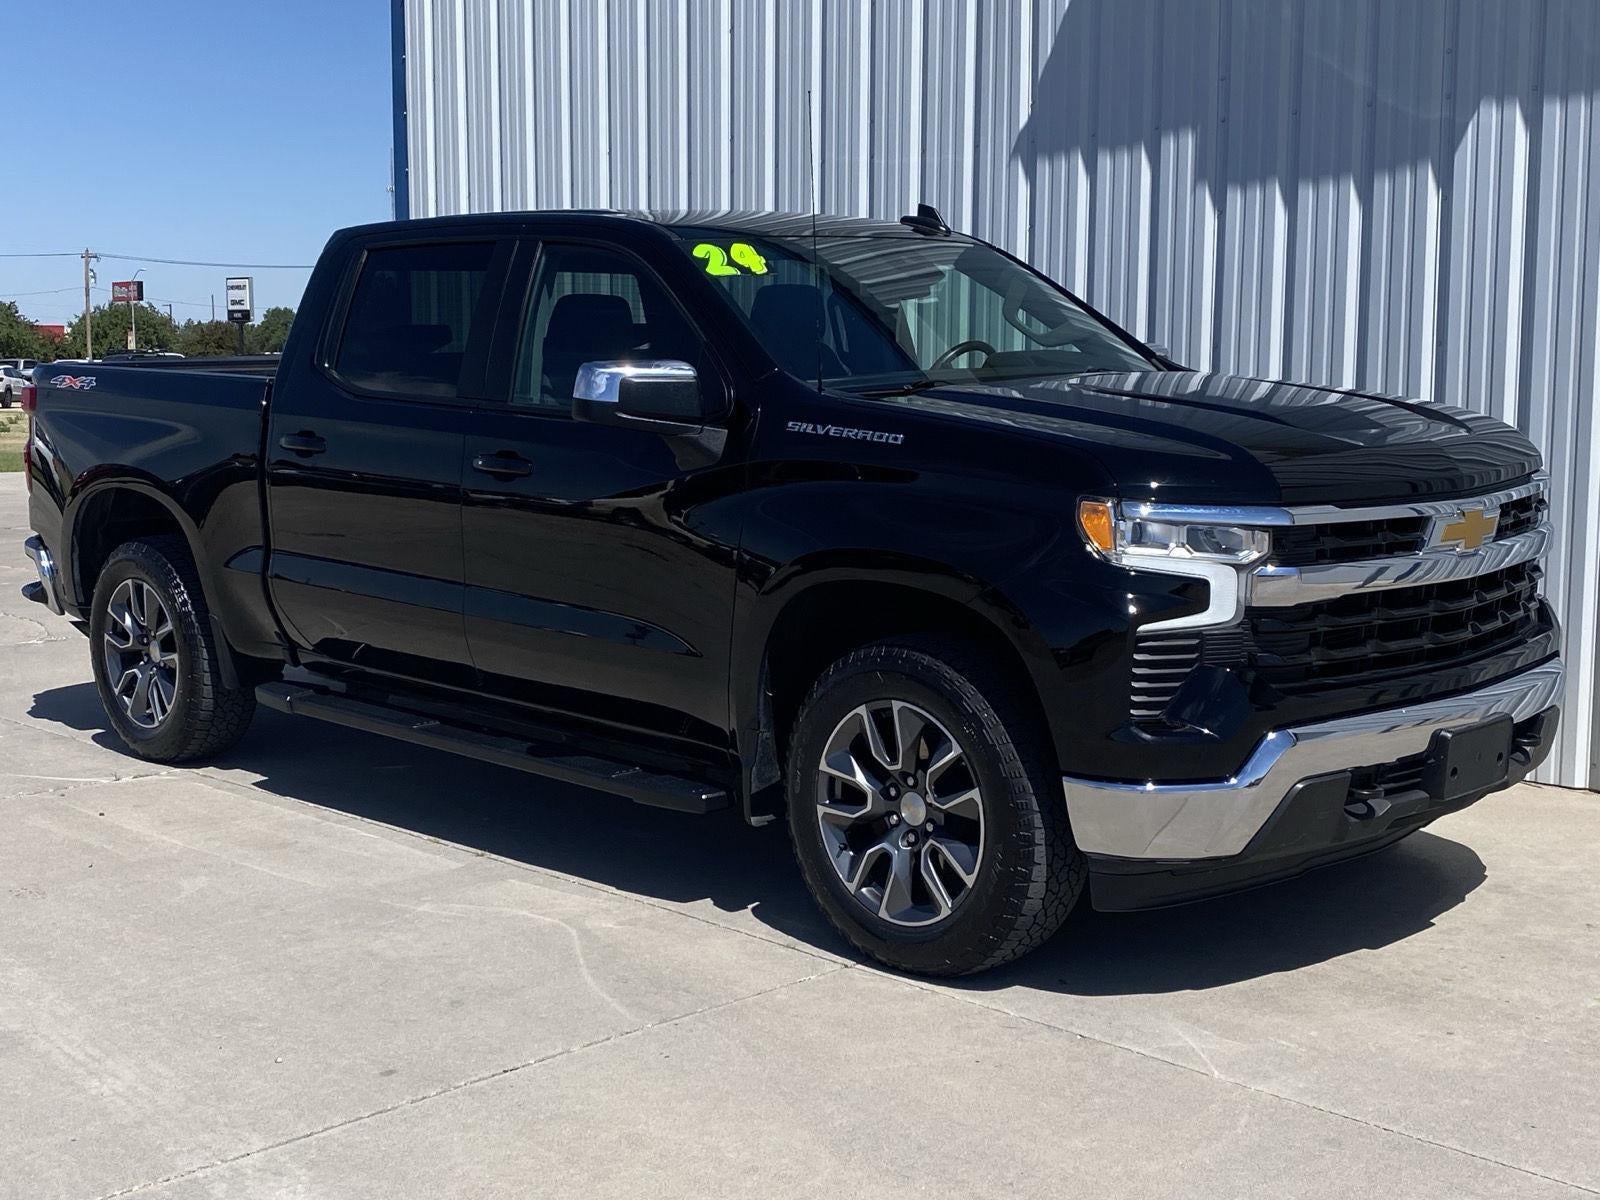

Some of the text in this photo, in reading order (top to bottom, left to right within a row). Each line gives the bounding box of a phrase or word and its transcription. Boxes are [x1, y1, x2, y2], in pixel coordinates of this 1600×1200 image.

[693, 243, 768, 275] 24
[50, 374, 96, 390] 4X4
[786, 421, 904, 444] SILVERADO
